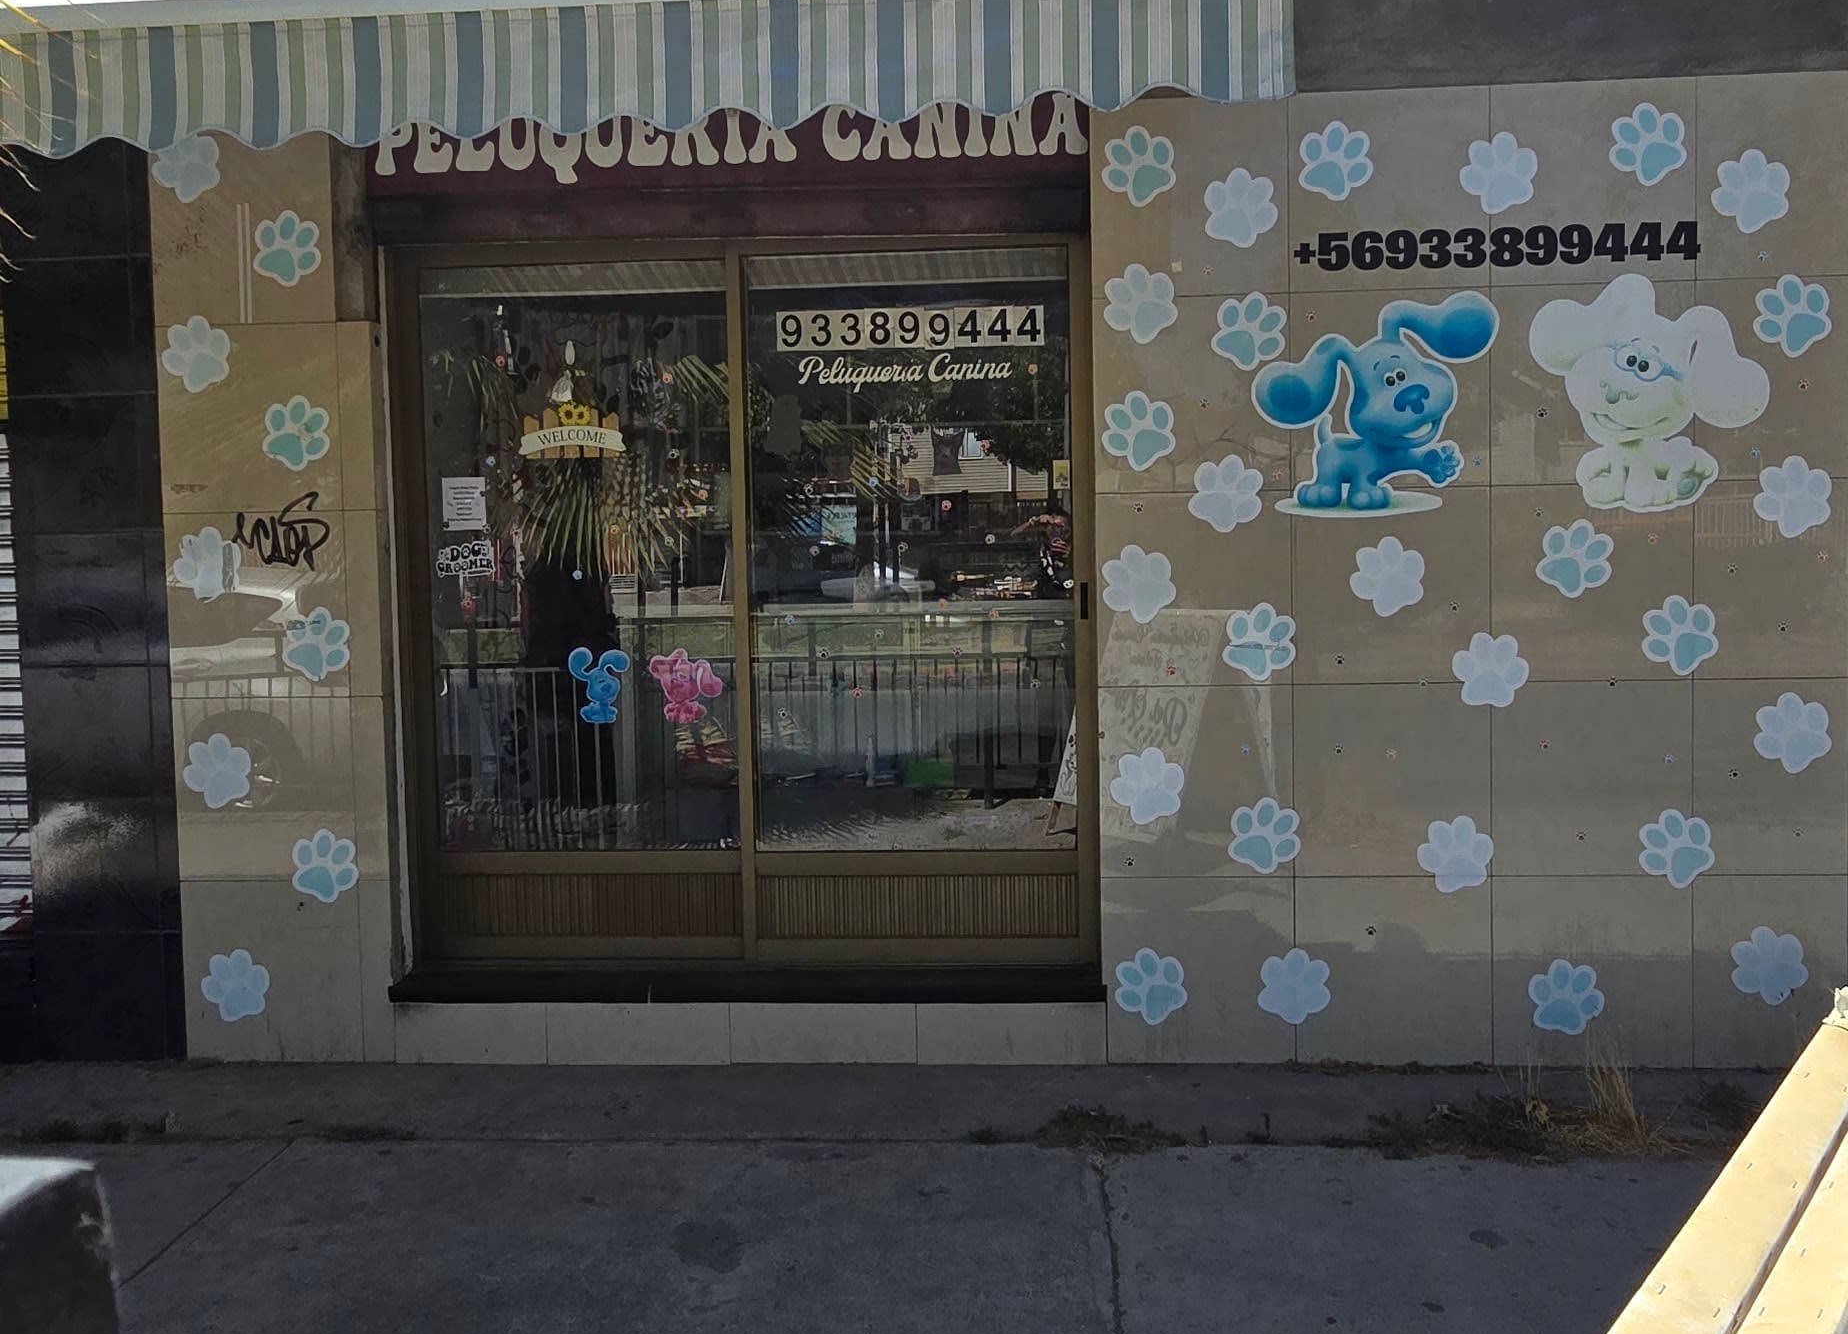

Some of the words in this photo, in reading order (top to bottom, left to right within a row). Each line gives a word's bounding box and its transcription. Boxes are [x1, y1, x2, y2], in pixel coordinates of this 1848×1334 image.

[1294, 220, 1701, 272] +56933899444
[780, 308, 1041, 348] 933899444
[927, 352, 1013, 383] Canina
[537, 429, 607, 446] WELCOME
[450, 543, 487, 562] DOG
[437, 558, 495, 574] GROOMER
